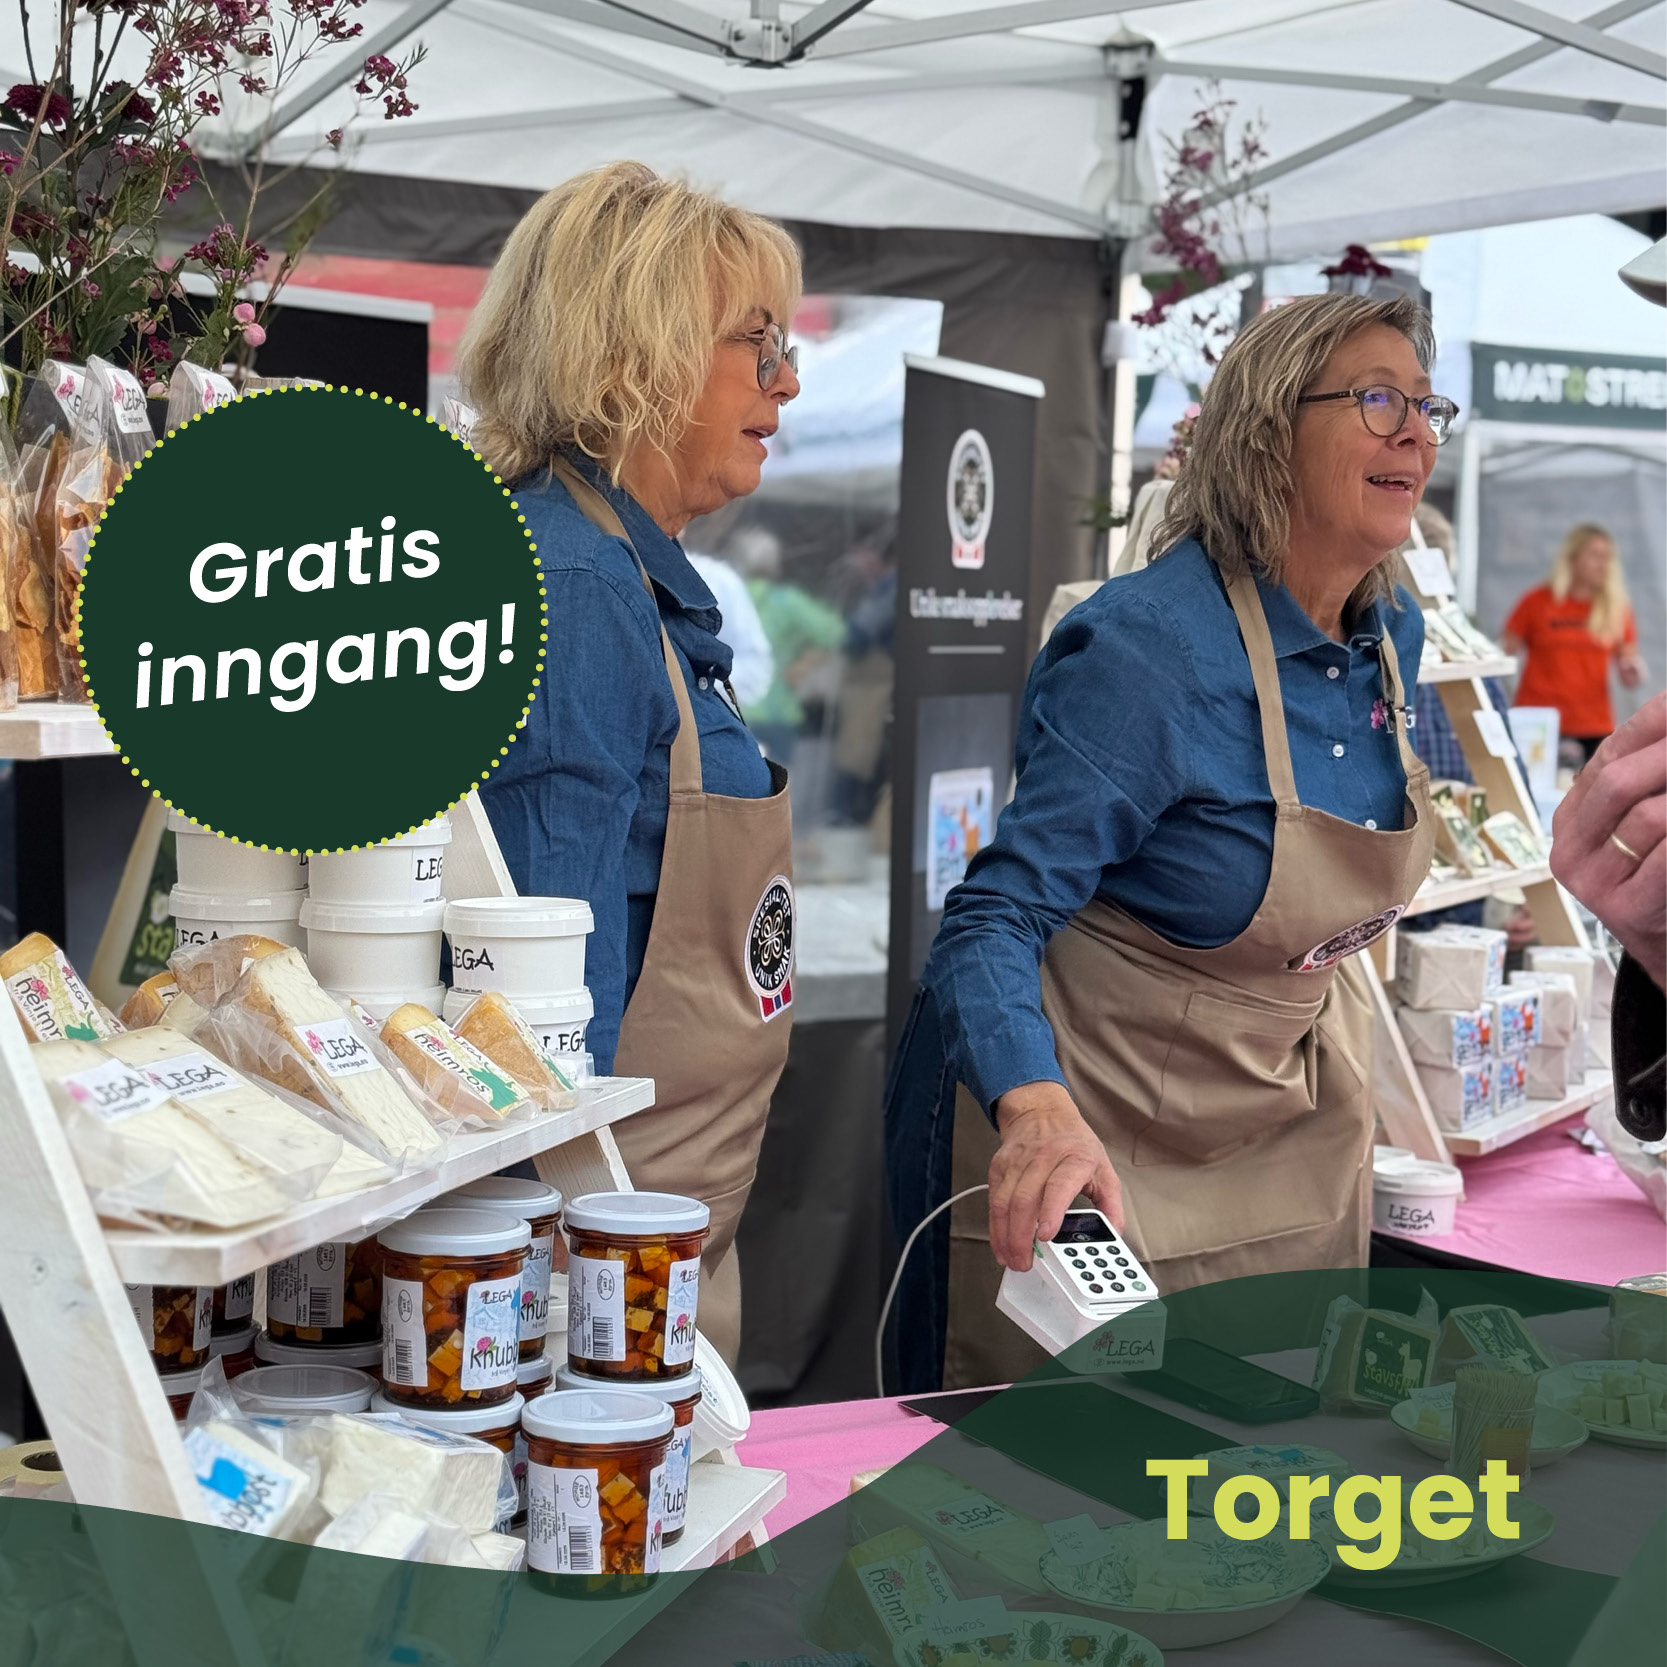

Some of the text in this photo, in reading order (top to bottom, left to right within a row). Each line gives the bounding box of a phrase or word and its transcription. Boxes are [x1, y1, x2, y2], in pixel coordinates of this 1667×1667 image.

[1493, 360, 1569, 403] MAT
[121, 388, 147, 411] LEGA
[753, 889, 791, 939] SPESIALITET
[755, 949, 791, 988] UNIK SMAK
[16, 977, 64, 1040] heimr
[65, 975, 90, 1011] LEGA
[319, 1035, 368, 1060] LEGA
[414, 1032, 490, 1094] heimros
[94, 1075, 151, 1106] LEGA
[153, 1064, 228, 1091] LEGA
[1388, 1204, 1435, 1224] LEGA
[484, 1290, 512, 1305] LEGA
[1106, 1339, 1156, 1357] LEGA
[950, 1504, 1005, 1526] LEGA
[926, 1570, 950, 1605] LEGA
